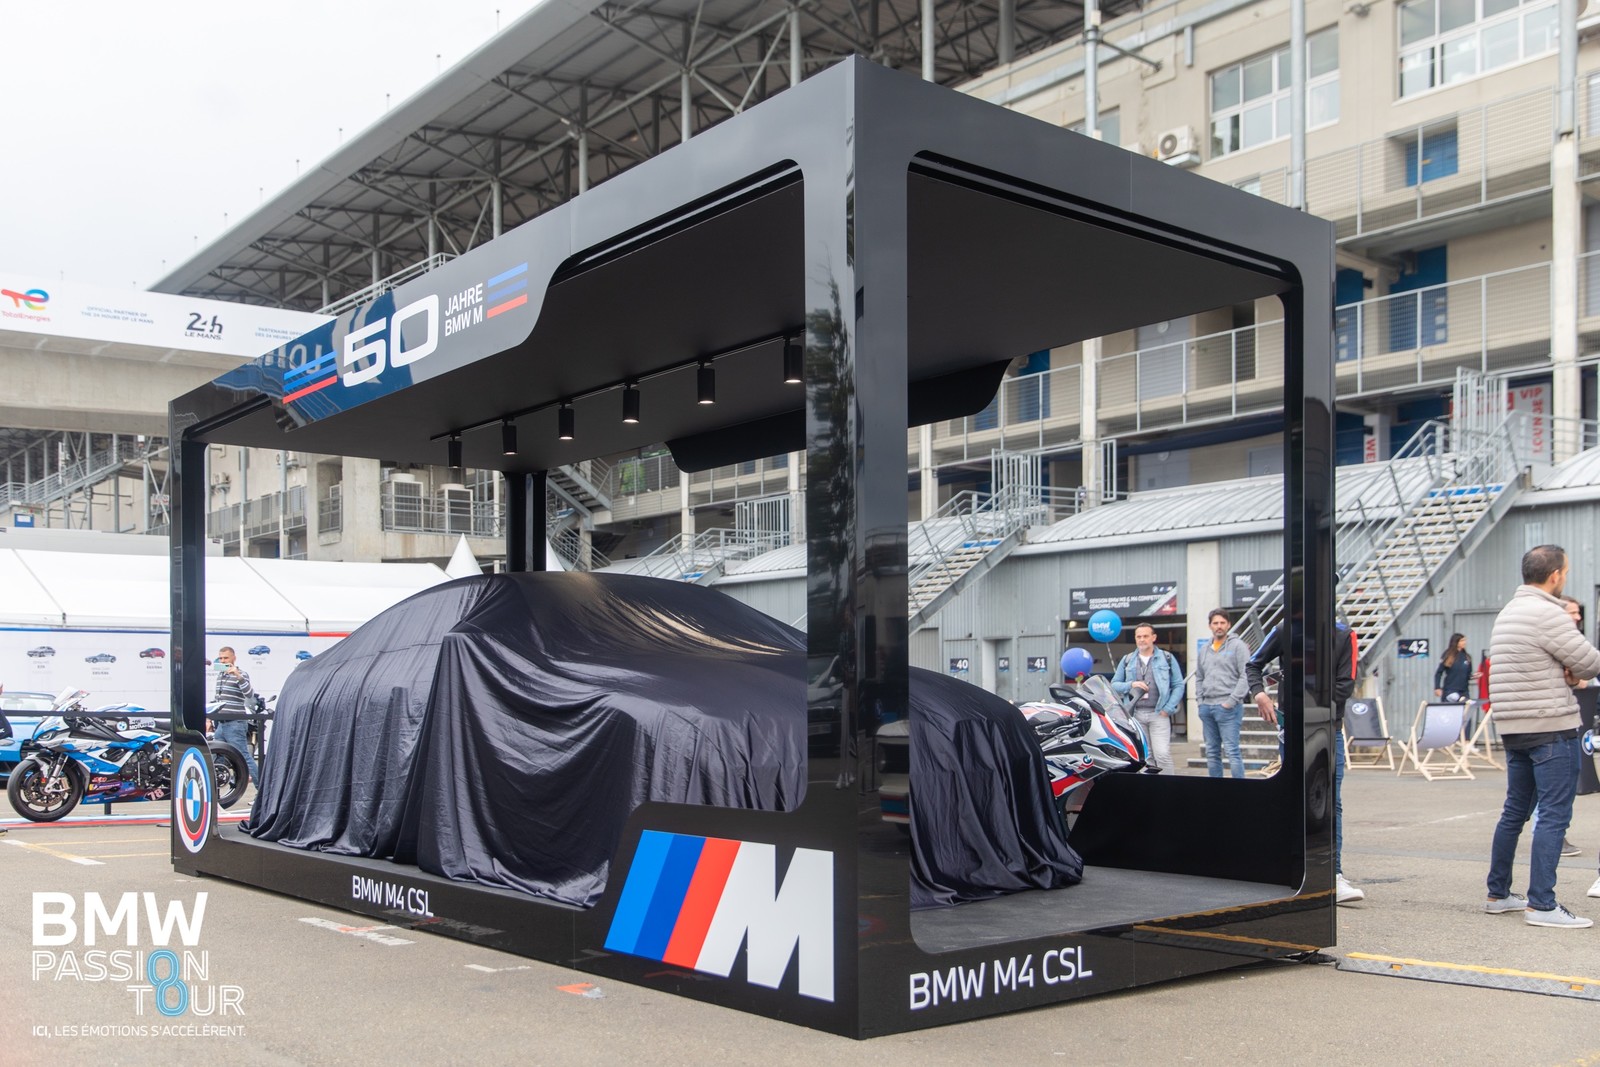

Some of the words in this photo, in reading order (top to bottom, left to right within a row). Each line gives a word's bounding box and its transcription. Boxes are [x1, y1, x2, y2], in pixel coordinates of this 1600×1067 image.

[445, 282, 483, 317] JAHRE
[1, 310, 51, 322] TotalEnergies
[87, 306, 112, 314] OFFICIAL
[114, 309, 139, 317] PARTNER
[445, 310, 471, 336] BMW
[473, 305, 483, 324] M
[196, 331, 222, 341] MANS
[342, 294, 439, 388] 50
[1520, 387, 1543, 400] VIP
[1408, 640, 1428, 653] 42
[956, 659, 968, 669] 40
[1034, 658, 1046, 668] 41
[184, 767, 203, 790] BMW
[147, 788, 165, 800] 78
[352, 874, 383, 904] BMW
[385, 882, 405, 910] M4
[407, 887, 434, 917] CSL
[909, 961, 986, 1010] BMW
[994, 954, 1034, 994] M4
[1042, 945, 1093, 984] CSL
